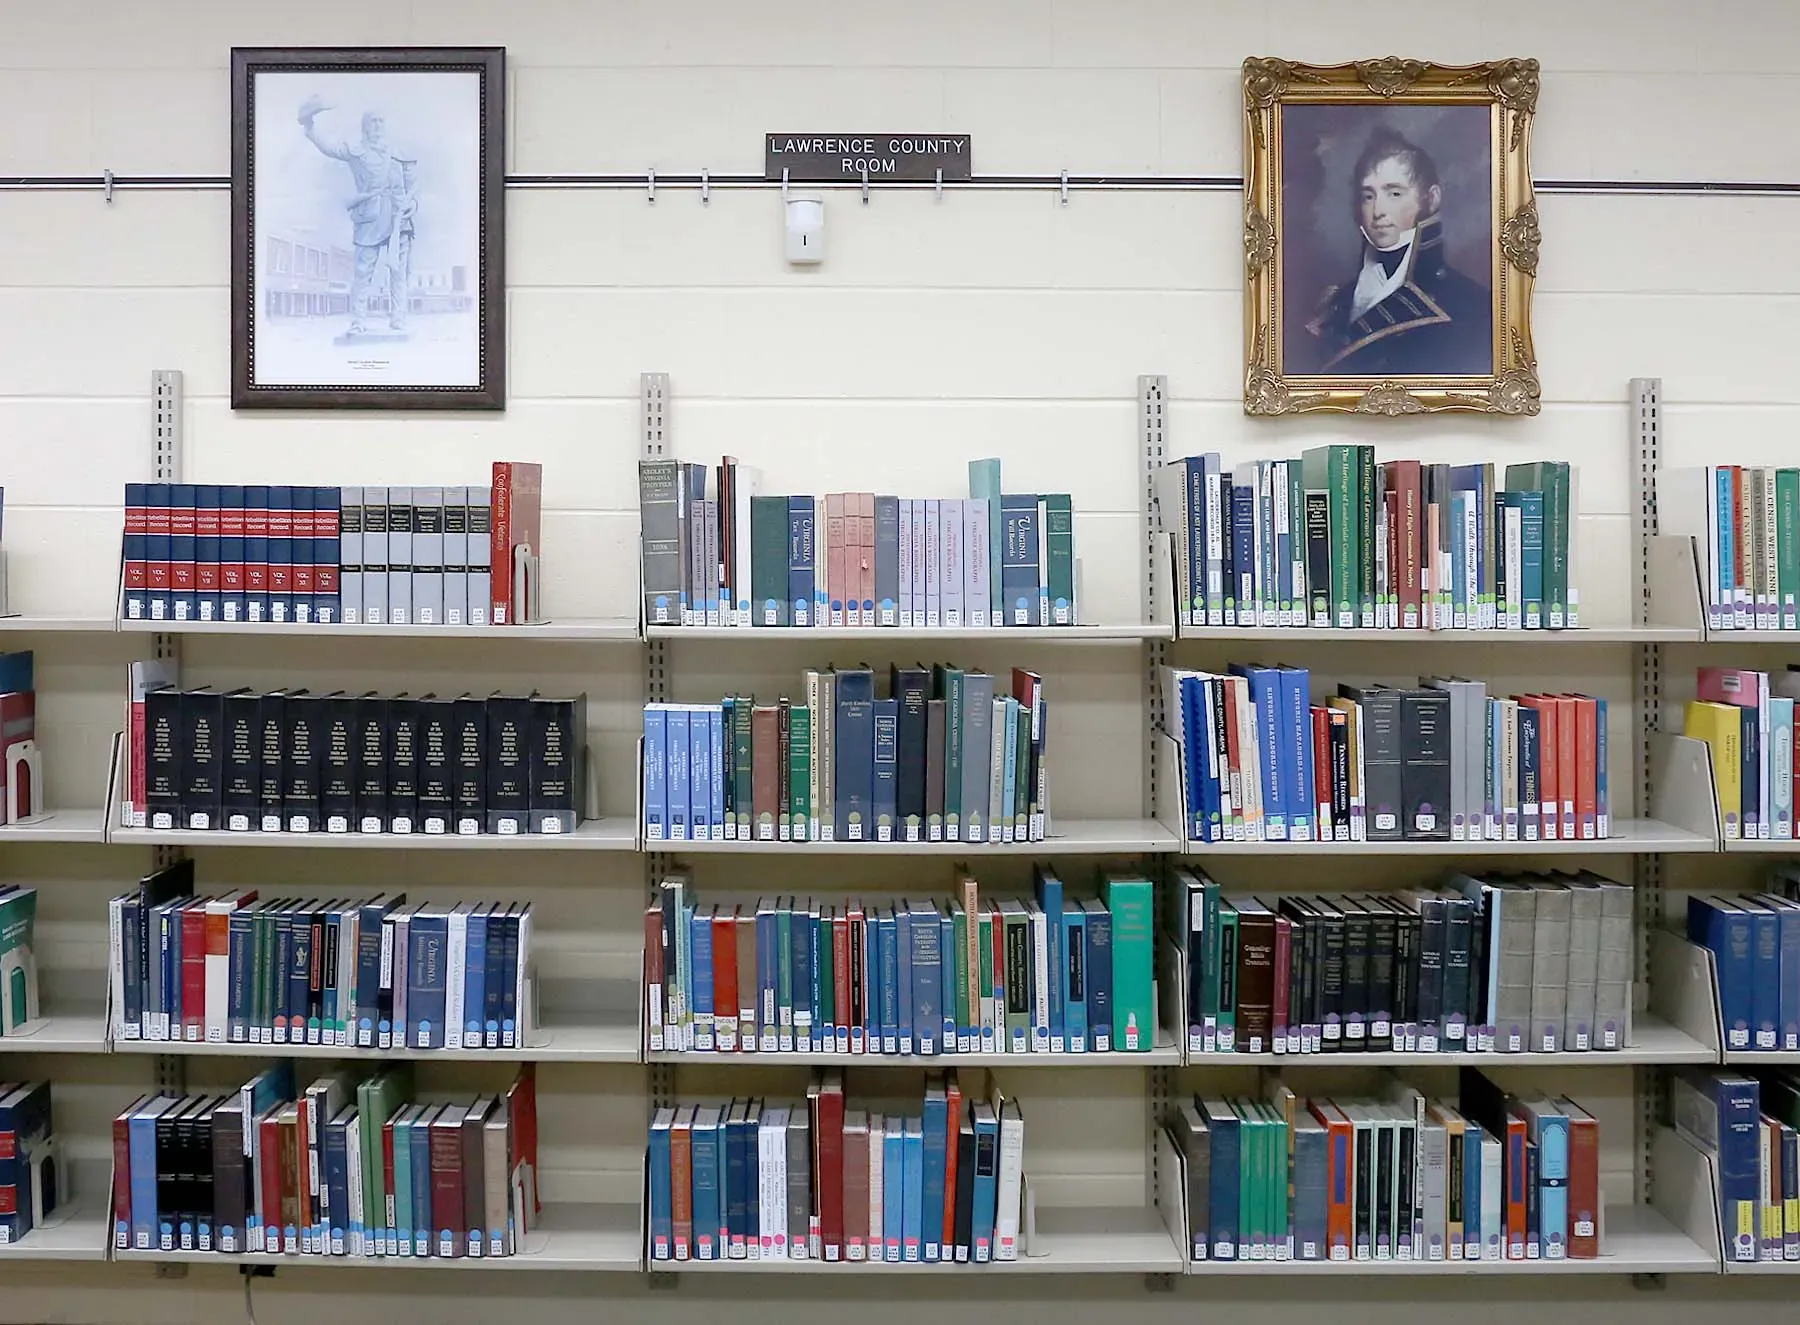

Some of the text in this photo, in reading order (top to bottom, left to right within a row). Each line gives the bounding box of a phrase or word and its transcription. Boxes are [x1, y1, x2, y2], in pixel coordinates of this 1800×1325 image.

[771, 138, 965, 154] LAWRENCE COUNTY
[842, 158, 896, 173] ROOM
[1340, 463, 1349, 494] Heritage
[1363, 463, 1371, 494] Heritage
[1342, 494, 1349, 502] of
[1365, 494, 1371, 502] of
[1468, 542, 1476, 573] Through
[1271, 771, 1279, 802] COUNTY
